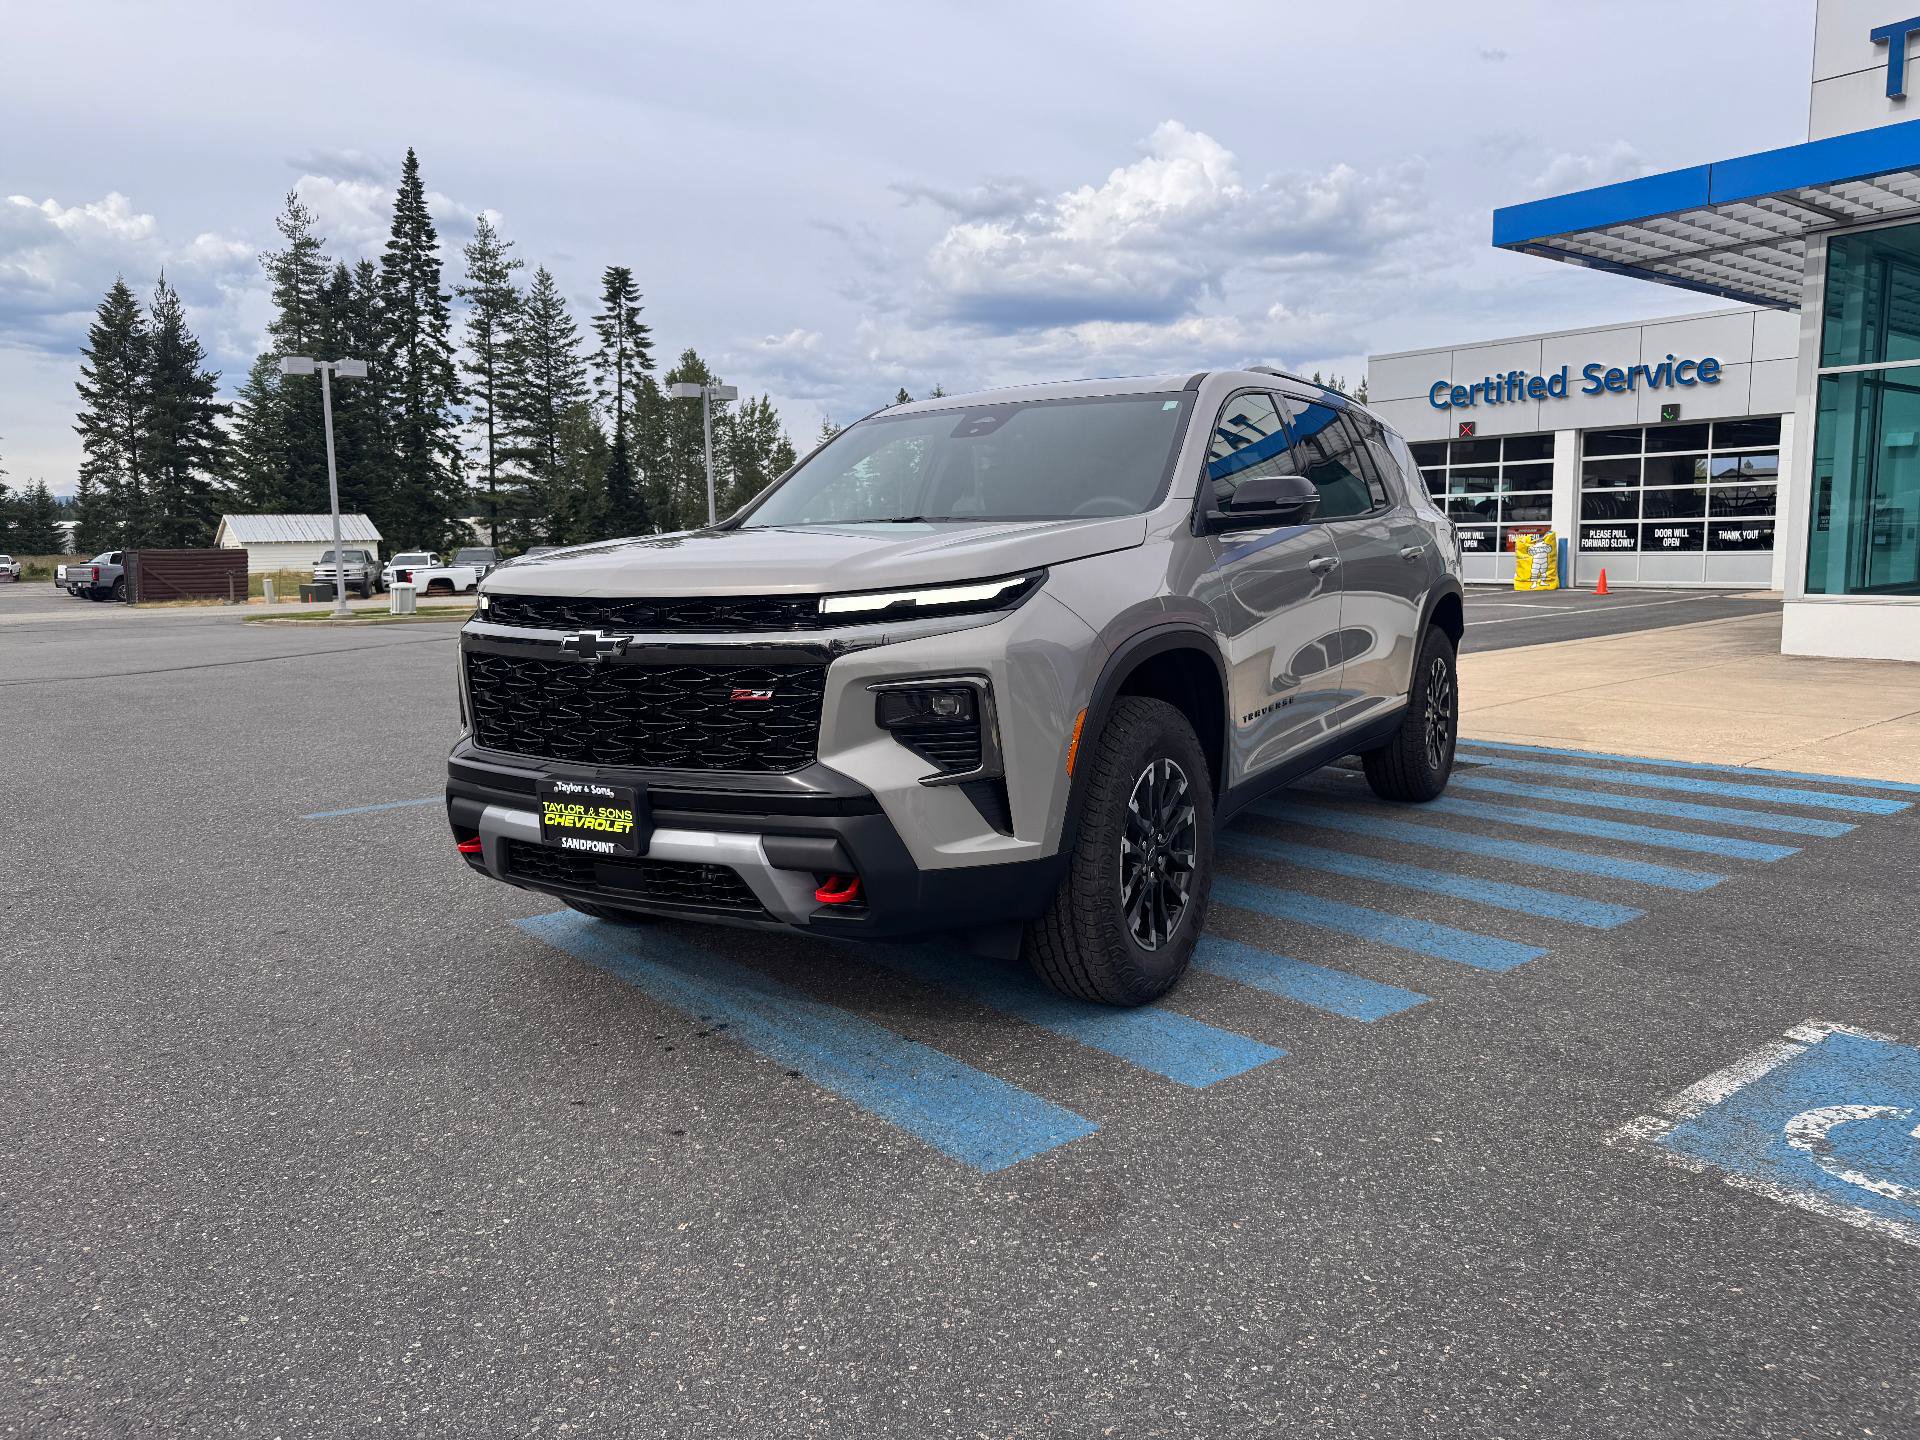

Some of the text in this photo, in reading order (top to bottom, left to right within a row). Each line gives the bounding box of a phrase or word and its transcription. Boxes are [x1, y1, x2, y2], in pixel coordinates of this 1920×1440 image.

[1429, 354, 1721, 409] Certified Service
[1472, 531, 1485, 539] WILL
[1589, 530, 1627, 538] PLEASE PULL
[1654, 529, 1689, 537] DOOR WILL
[1718, 529, 1759, 540] THANK YOU!
[1581, 539, 1635, 547] FORWARD SLOWLY
[1662, 538, 1680, 546] OPEN
[1242, 696, 1295, 723] TRAVERSE
[556, 782, 582, 794] Taylor
[591, 785, 611, 796] Sons
[543, 802, 632, 820] TAYLOR & SONS
[544, 814, 633, 834] CHEVROLET
[561, 837, 615, 854] SANDPOINT
